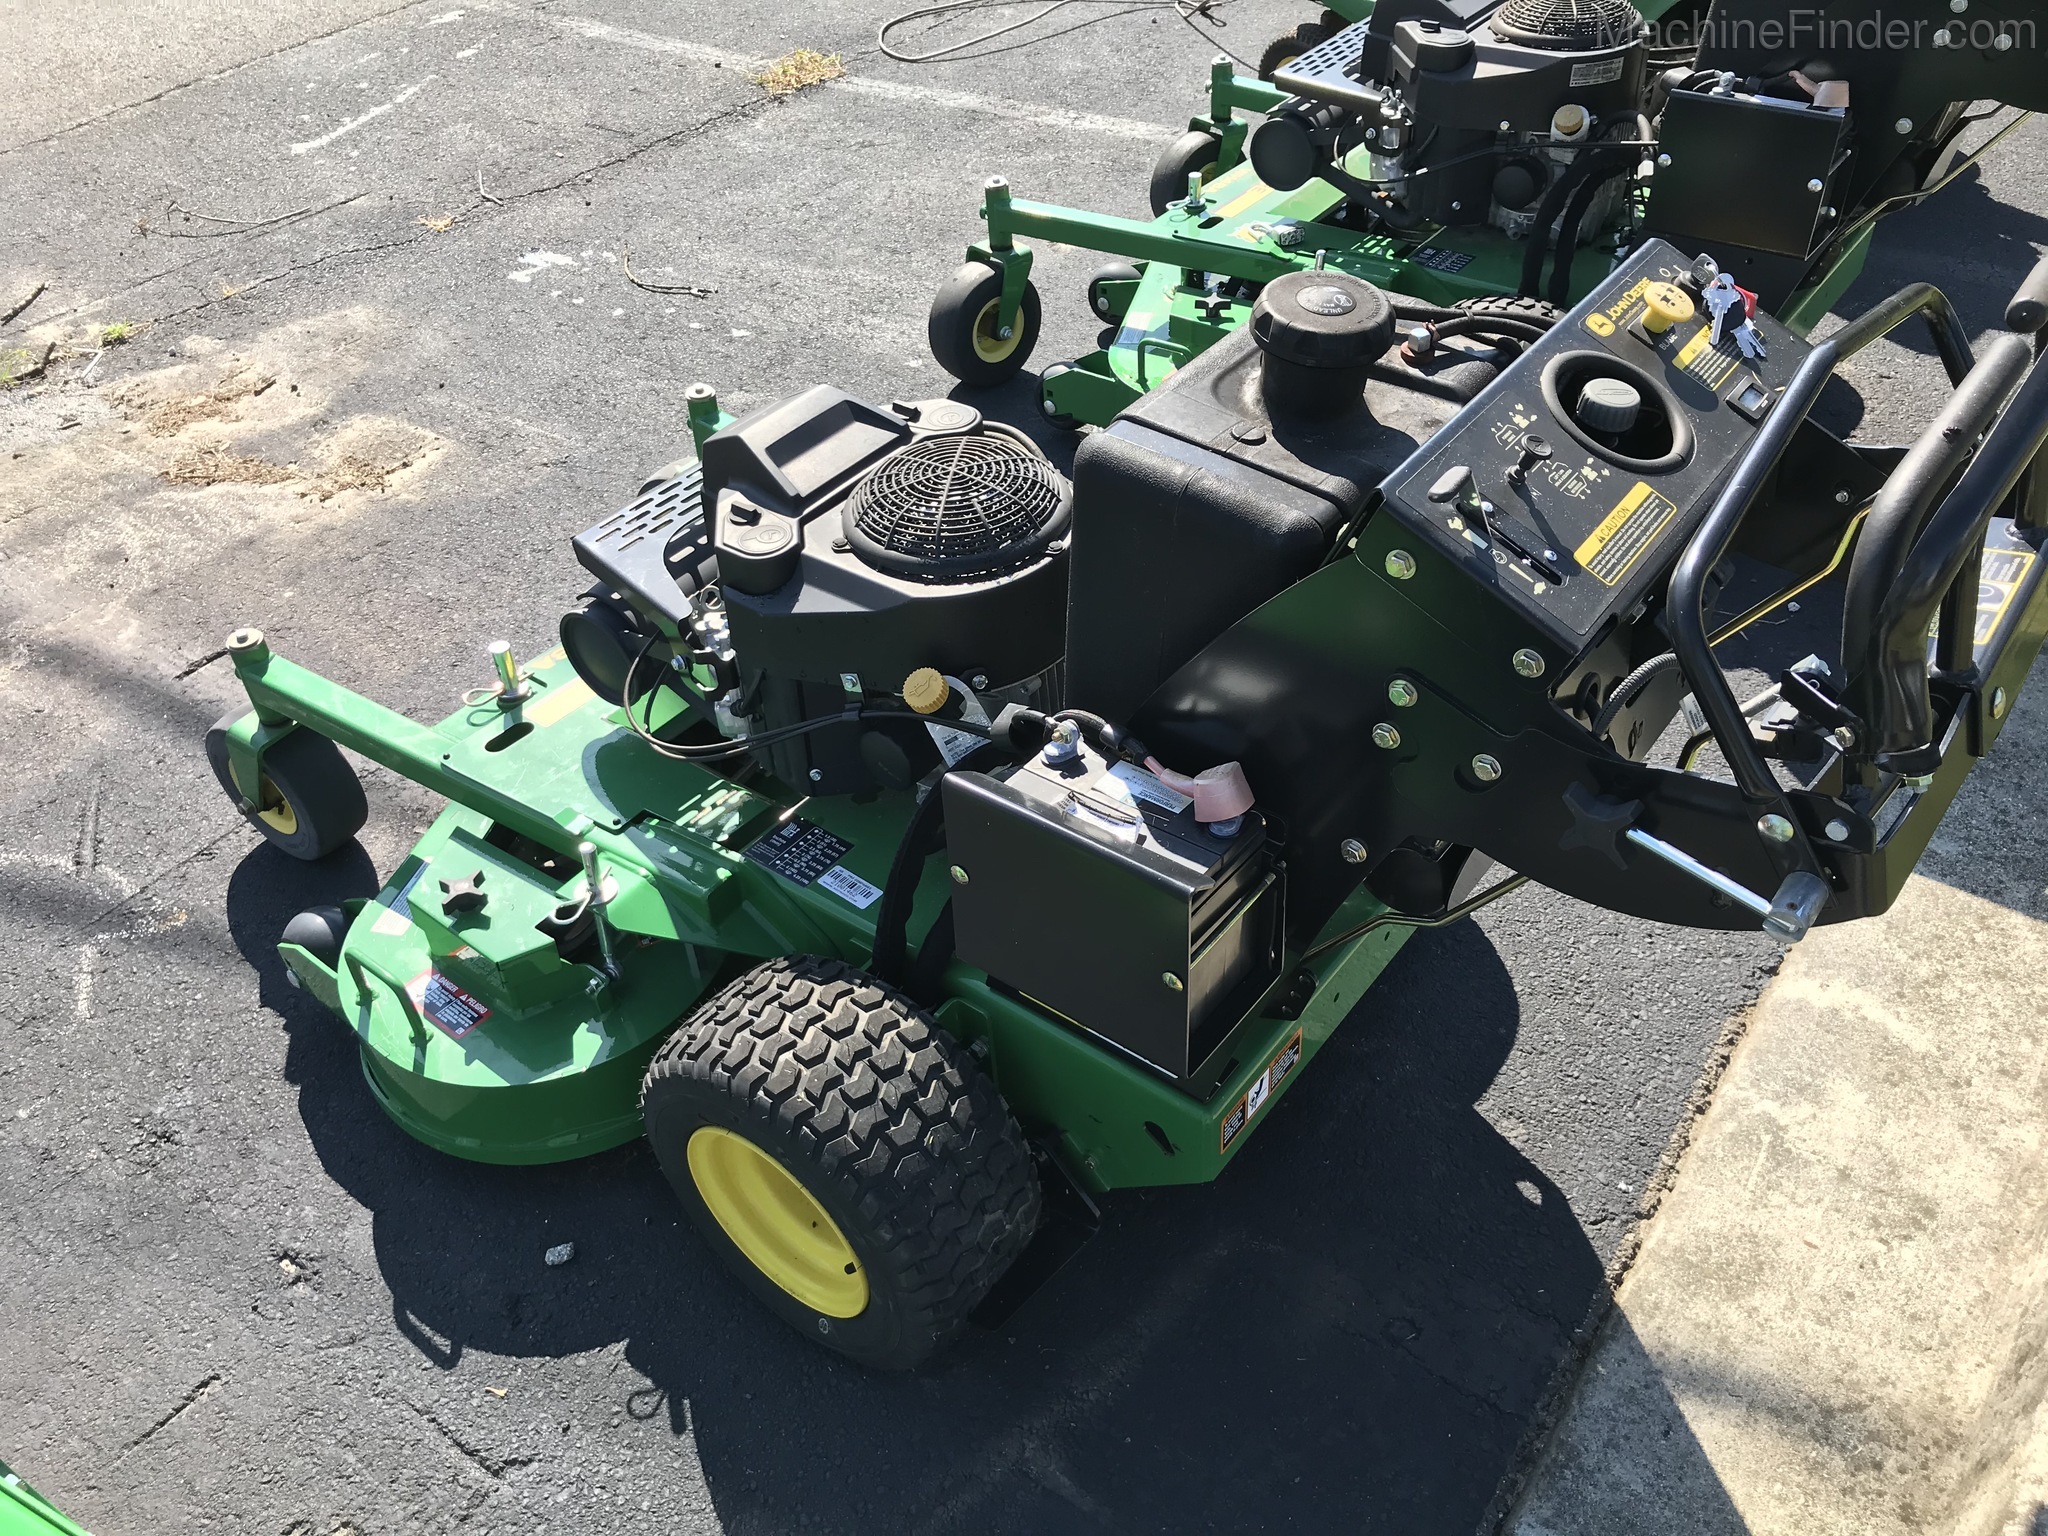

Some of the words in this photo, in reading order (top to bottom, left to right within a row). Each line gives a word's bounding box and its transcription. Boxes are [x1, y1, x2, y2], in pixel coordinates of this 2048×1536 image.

[1605, 296, 1632, 321] JOHN
[1623, 276, 1654, 301] DEERE
[1600, 505, 1631, 537] CAUTION
[1138, 790, 1177, 811] PERFORMANCE
[438, 976, 459, 992] DANGER
[466, 997, 488, 1014] PELIGRO
